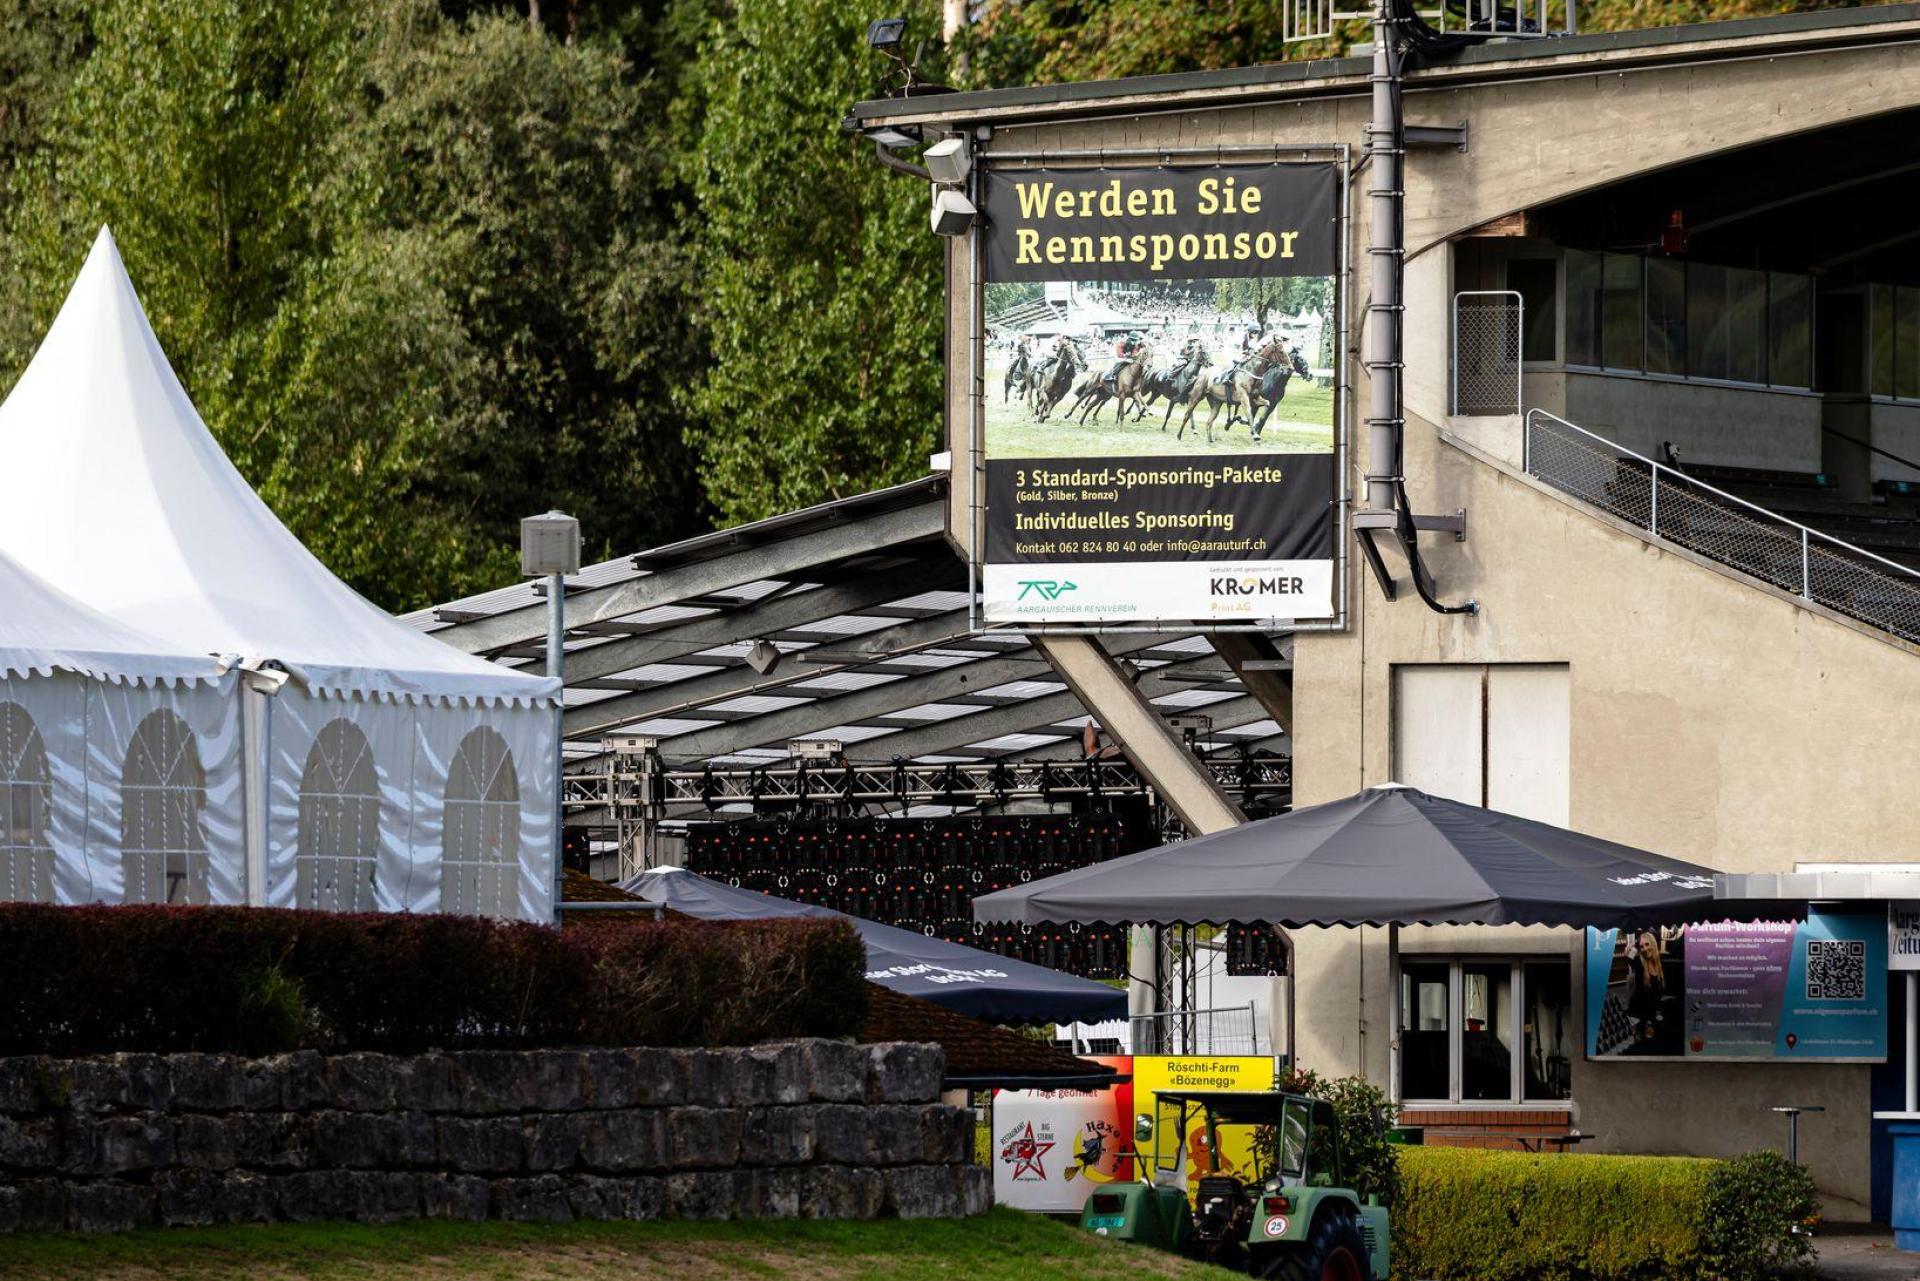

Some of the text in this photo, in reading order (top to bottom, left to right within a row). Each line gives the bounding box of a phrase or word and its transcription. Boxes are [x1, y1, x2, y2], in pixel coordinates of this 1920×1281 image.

[1015, 176, 1262, 219] Werden Sie
[1015, 228, 1299, 271] Rennsponsor
[1016, 465, 1282, 489] 3 Standard-Sponsoring-Pakete
[1016, 489, 1119, 503] (Gold, Silber, Bronze)
[1015, 509, 1234, 532] Individuelles Sponsoring
[1016, 538, 1267, 554] Kontakt 062 824 80 40 oder info@aarauturf.ch
[1210, 576, 1304, 596] KROMER
[1085, 604, 1137, 613] RENNVEREIN
[1236, 602, 1251, 611] AG
[1167, 1061, 1240, 1073] Röschti-Farm
[1170, 1075, 1236, 1088] «Bözenegg»
[1269, 1220, 1284, 1232] 25
